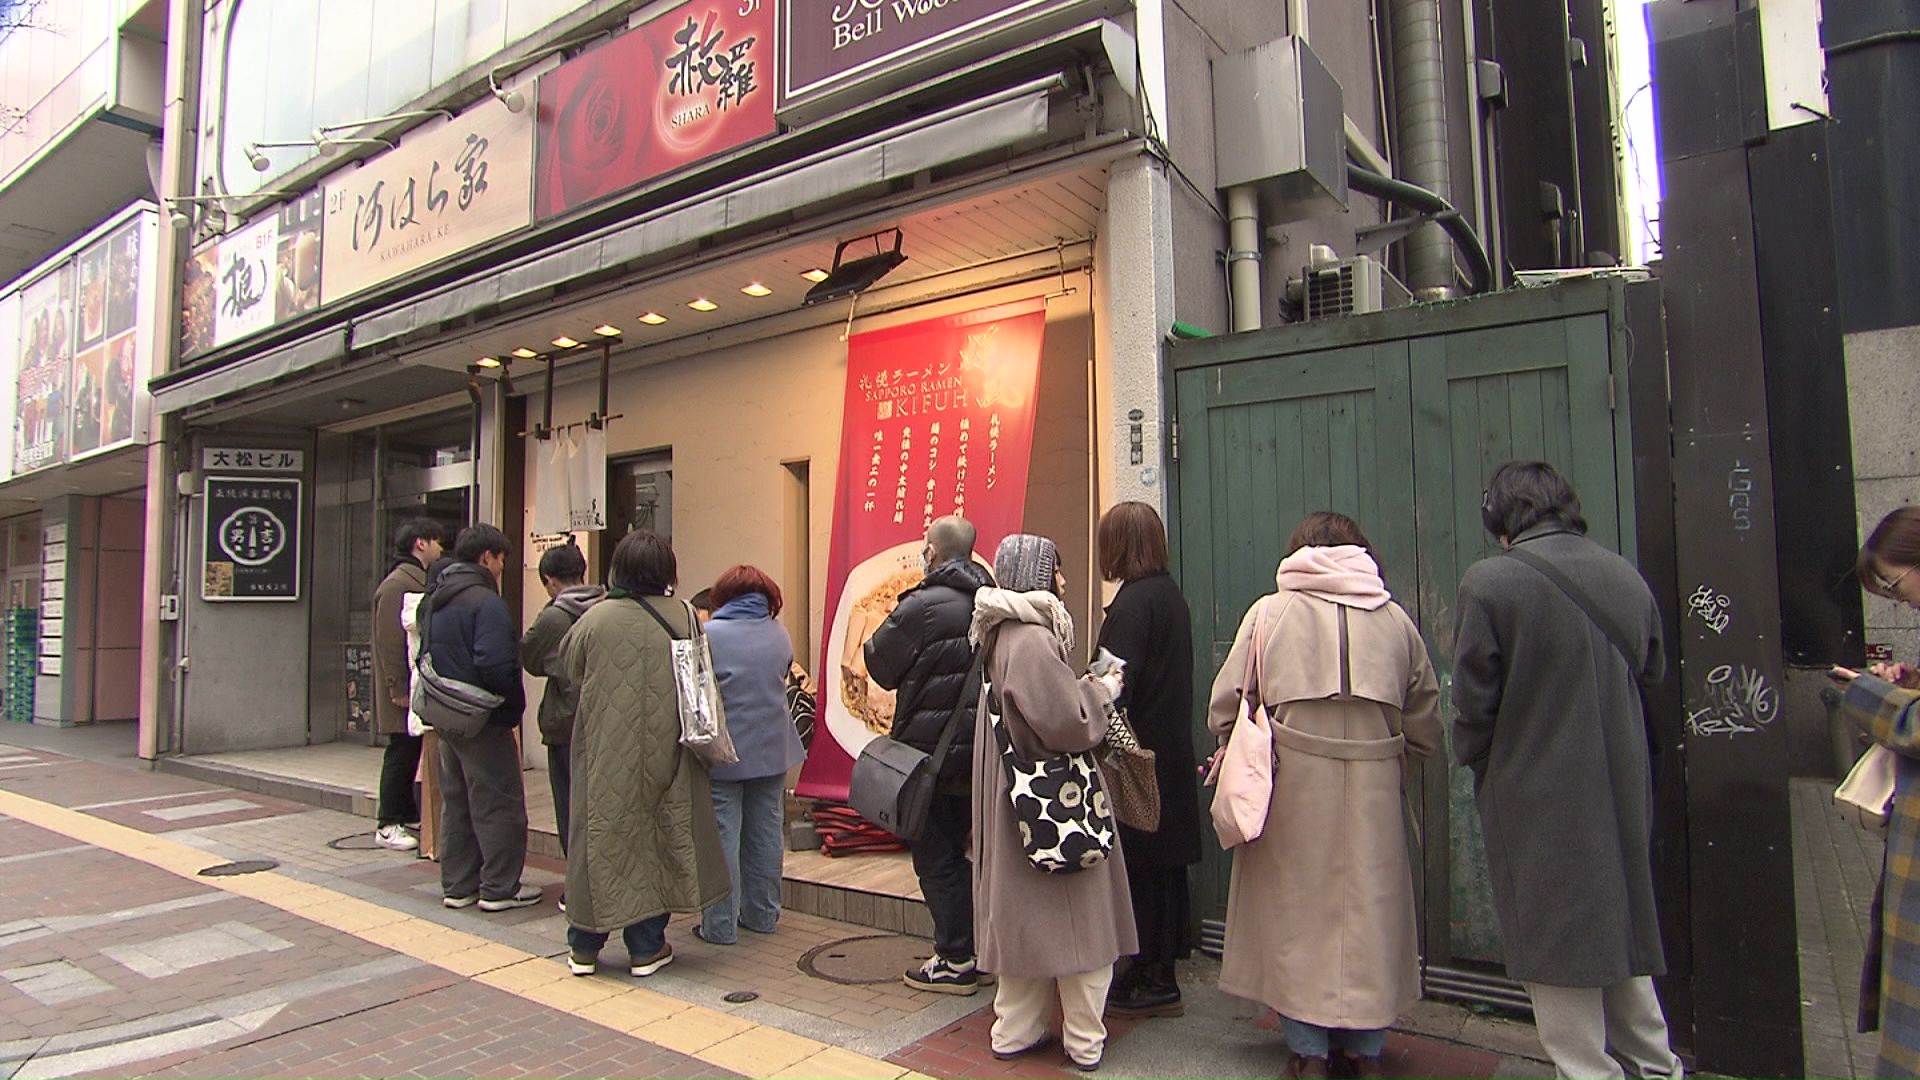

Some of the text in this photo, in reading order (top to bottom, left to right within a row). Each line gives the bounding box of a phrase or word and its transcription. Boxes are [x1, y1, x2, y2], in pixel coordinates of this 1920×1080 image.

[832, 8, 883, 50] Bell
[671, 104, 711, 130] SHARA
[329, 189, 347, 215] 2F
[256, 229, 273, 249] B1F
[859, 361, 951, 391] 札幌ラーメン
[865, 376, 962, 402] SAPPORO RAMEN
[896, 387, 967, 417] KIFUH
[212, 451, 294, 468] 大松ビル
[986, 413, 1000, 489] 札幌ラーメン
